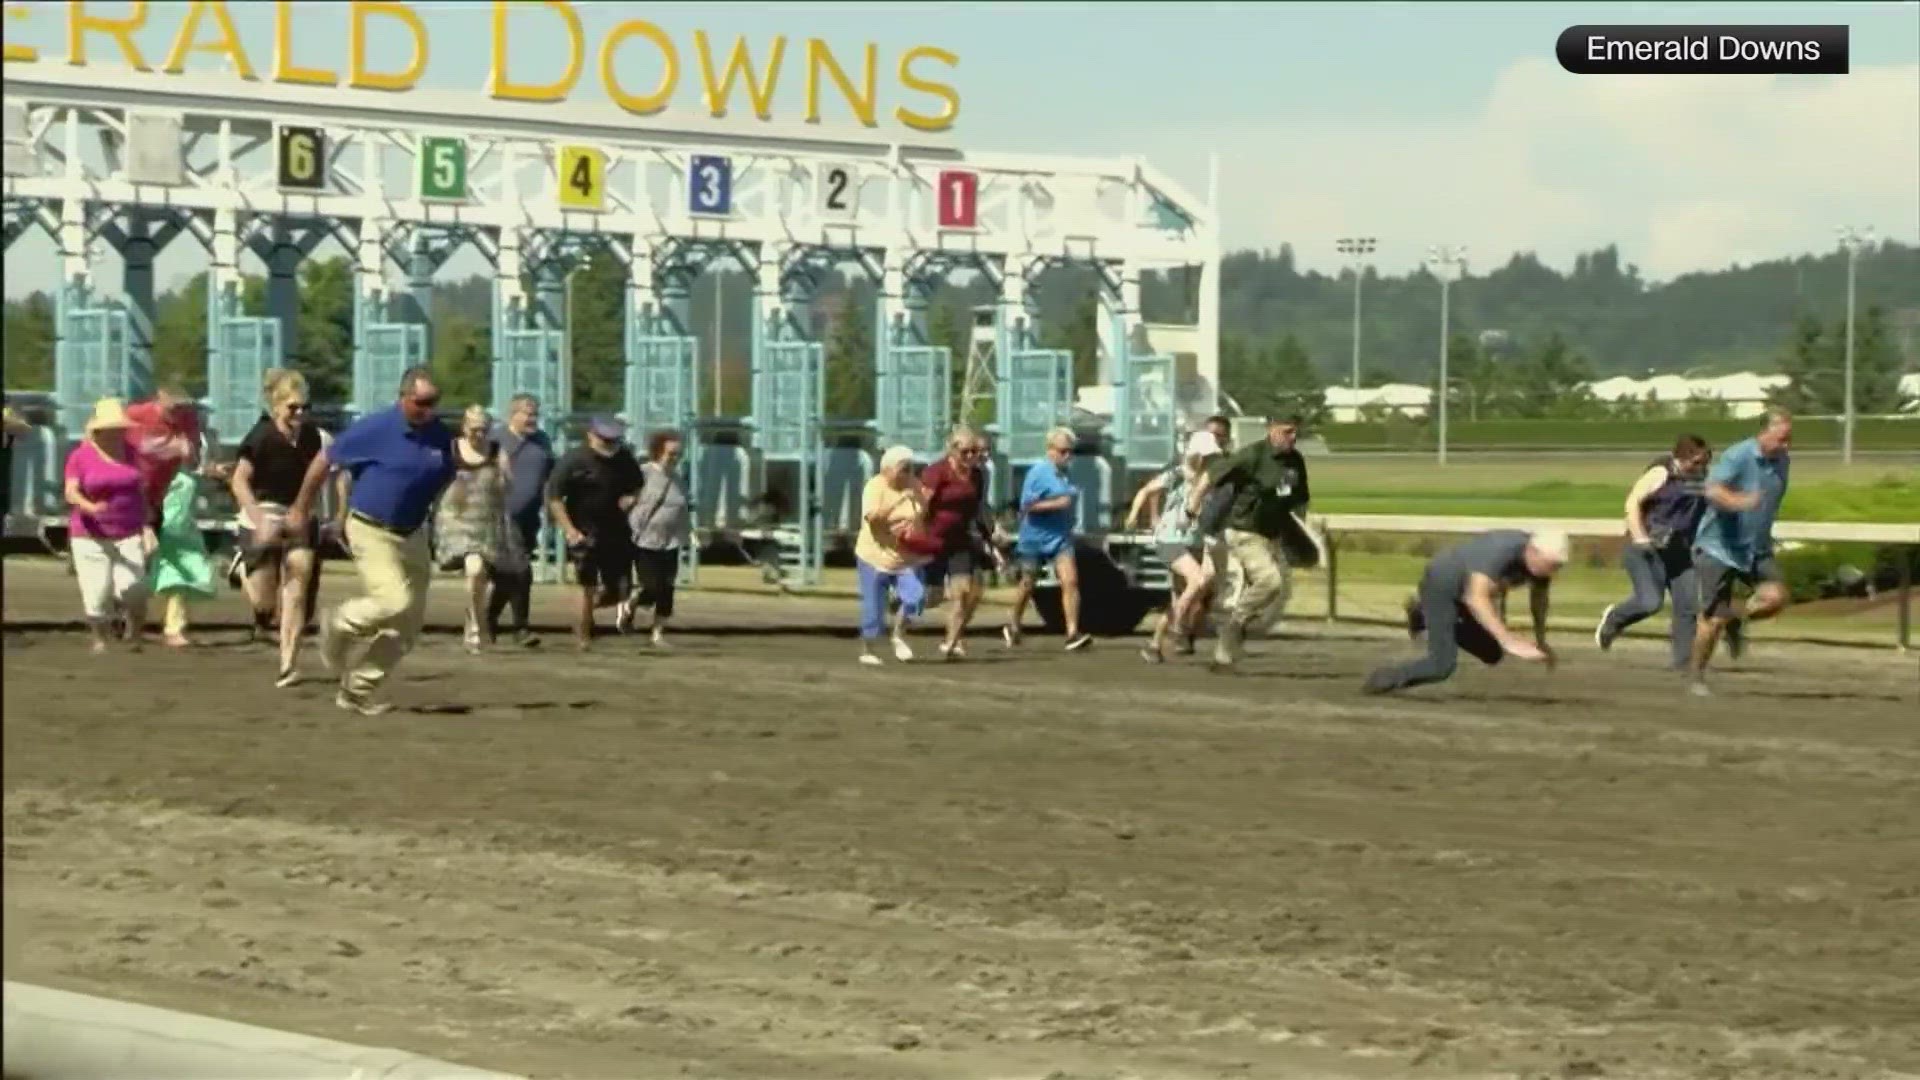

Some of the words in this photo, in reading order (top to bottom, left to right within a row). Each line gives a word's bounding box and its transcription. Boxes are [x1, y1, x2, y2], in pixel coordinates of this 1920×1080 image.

[490, 2, 962, 131] DOWNS
[289, 135, 315, 180] 6
[433, 148, 456, 188] 5
[569, 155, 592, 197] 4
[699, 166, 721, 207] 3
[826, 169, 847, 210] 2
[951, 180, 965, 219] 1
